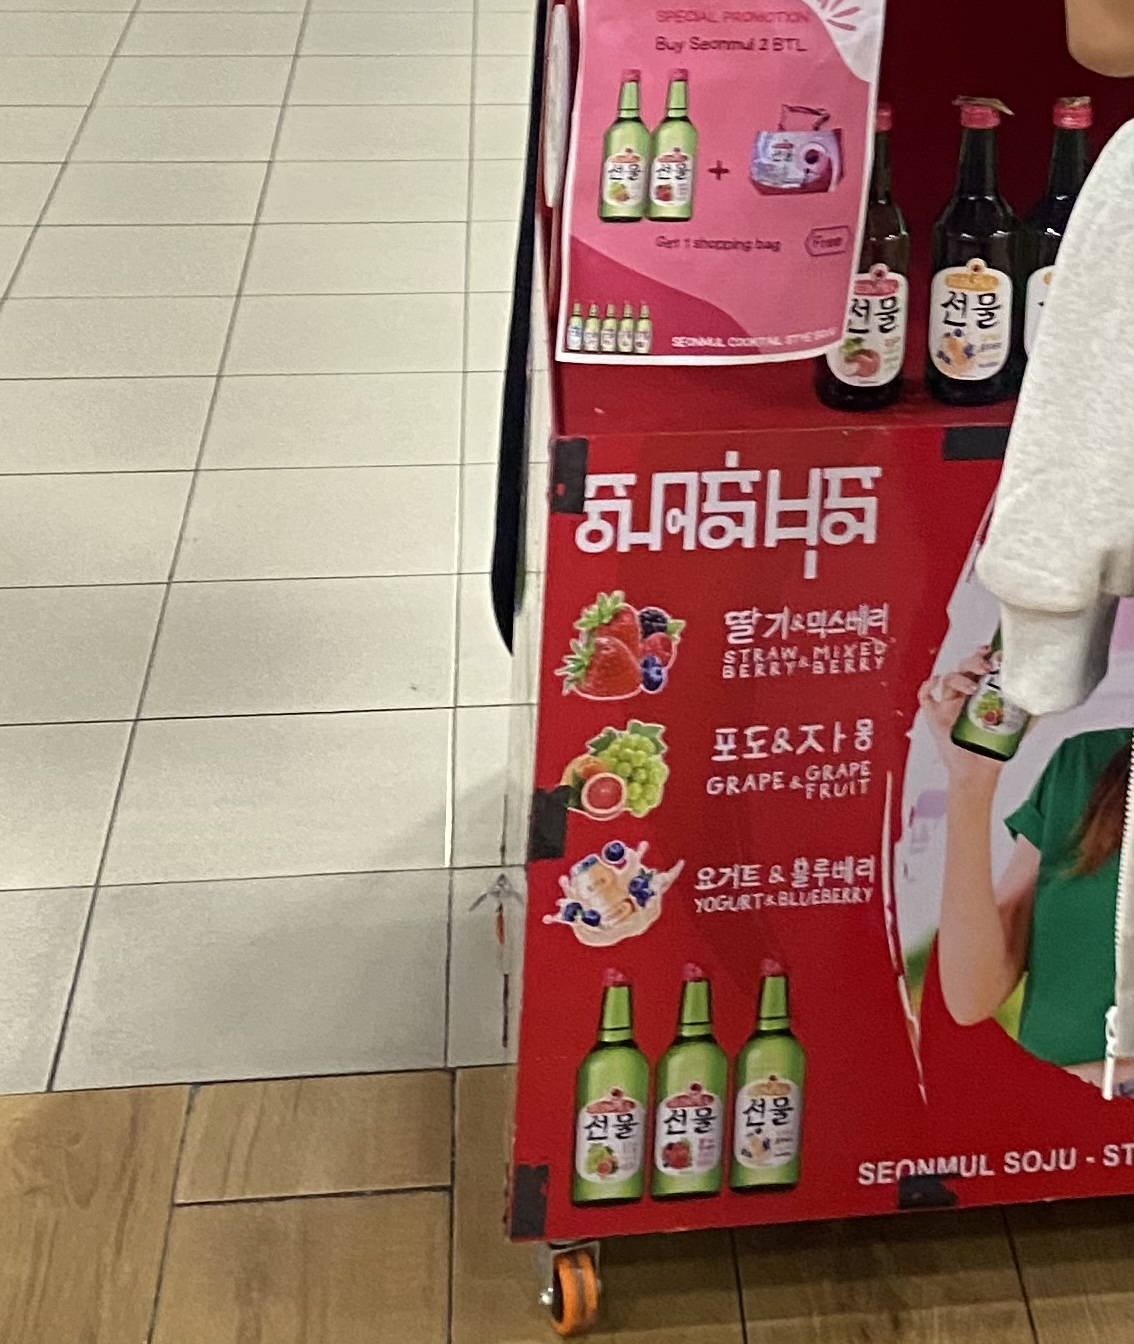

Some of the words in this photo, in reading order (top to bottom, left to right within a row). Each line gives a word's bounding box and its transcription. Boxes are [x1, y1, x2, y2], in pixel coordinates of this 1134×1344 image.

[655, 10, 718, 23] SPECIAL
[722, 10, 810, 23] PROMOTION
[655, 36, 683, 53] Buy
[689, 36, 754, 51] Seonmul
[757, 38, 768, 51] 2
[772, 37, 808, 52] BTL
[723, 645, 799, 664] STRAW
[812, 641, 888, 661] MIXED
[722, 663, 797, 679] BERRY
[812, 656, 885, 675] BERRY
[706, 771, 785, 796] GRAPE
[805, 760, 872, 782] GRAPE
[805, 777, 871, 800] FRUIT
[1003, 1146, 1077, 1174] SOJU
